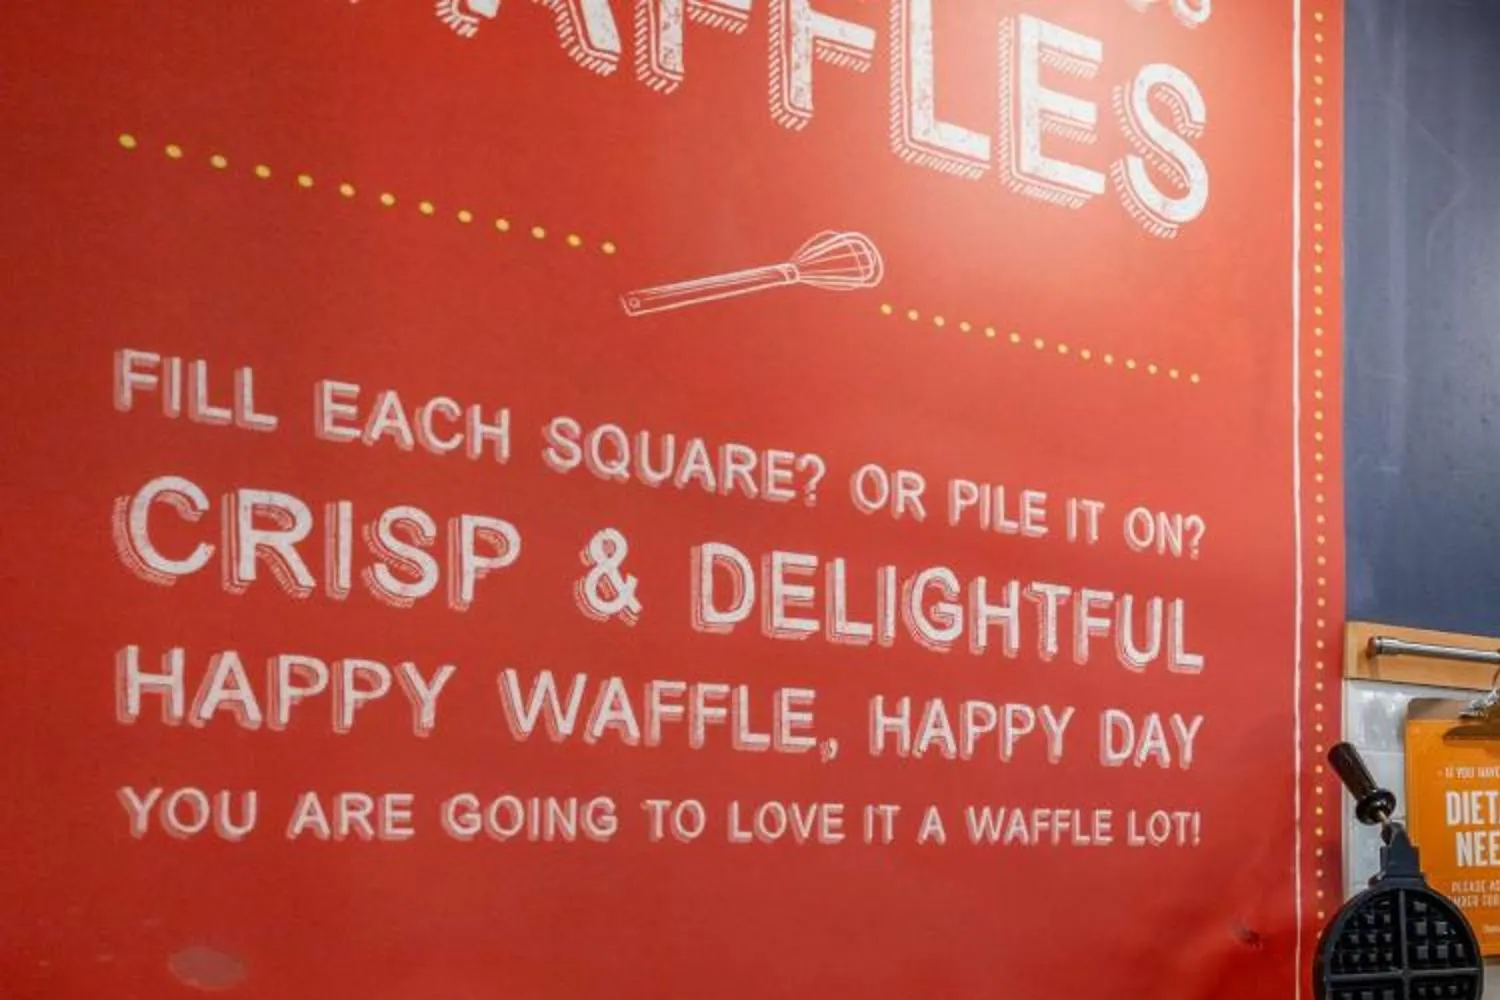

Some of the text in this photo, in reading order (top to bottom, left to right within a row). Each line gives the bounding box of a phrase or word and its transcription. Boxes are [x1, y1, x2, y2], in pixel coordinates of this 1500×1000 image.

[114, 348, 1206, 560] FILL EACH SQUARE? OR PILE IT ON?
[112, 474, 1204, 675] CRISP & DELIGHTFUL
[116, 644, 1203, 770] HAPPY WAFFLE, HAPPY DAY
[116, 786, 1201, 848] YOU ARE GOING TO LOVE IT A WAFFLE LOT!
